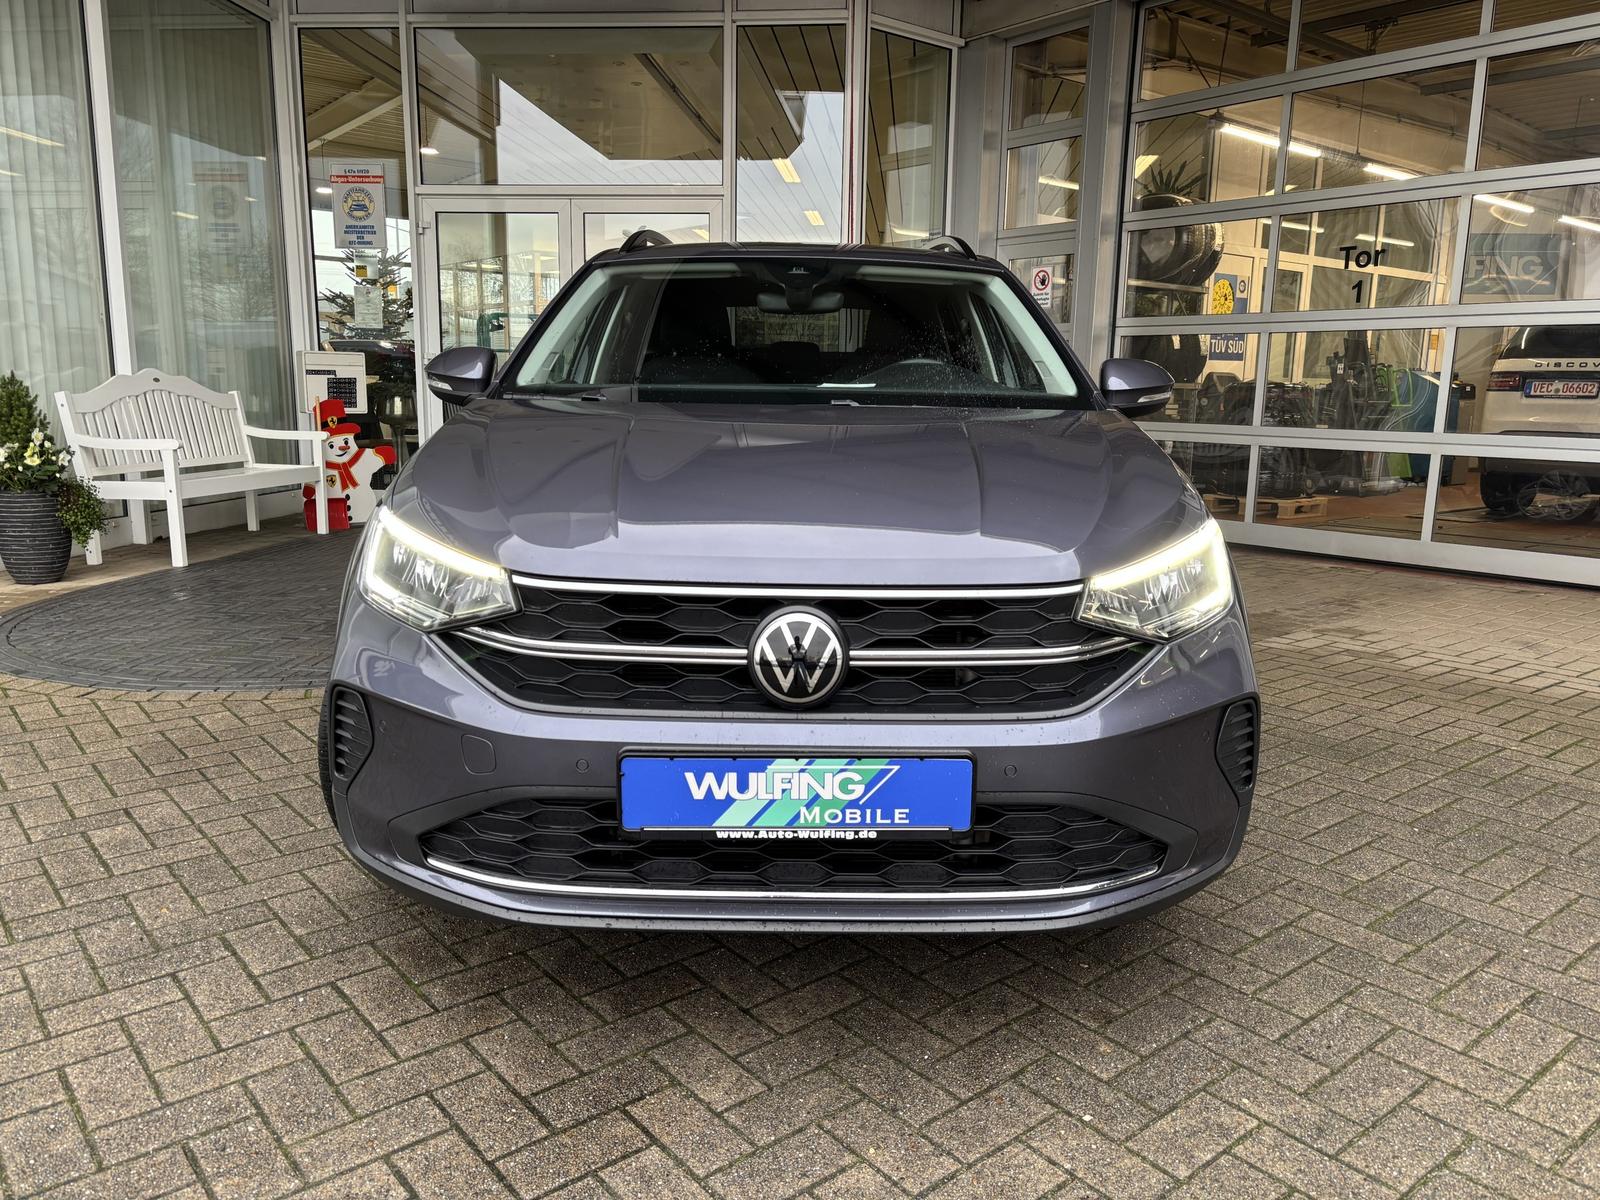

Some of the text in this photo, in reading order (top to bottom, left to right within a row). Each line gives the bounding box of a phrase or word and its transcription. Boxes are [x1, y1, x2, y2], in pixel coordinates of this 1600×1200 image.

[1339, 245, 1386, 269] Tor
[1351, 279, 1363, 304] 1
[1211, 336, 1244, 354] TÜV SÜD
[1533, 382, 1596, 394] VEC 06602
[683, 771, 866, 801] WULFING
[799, 806, 910, 824] MOBILE
[715, 830, 877, 840] www.Auto-Wulfing.de
